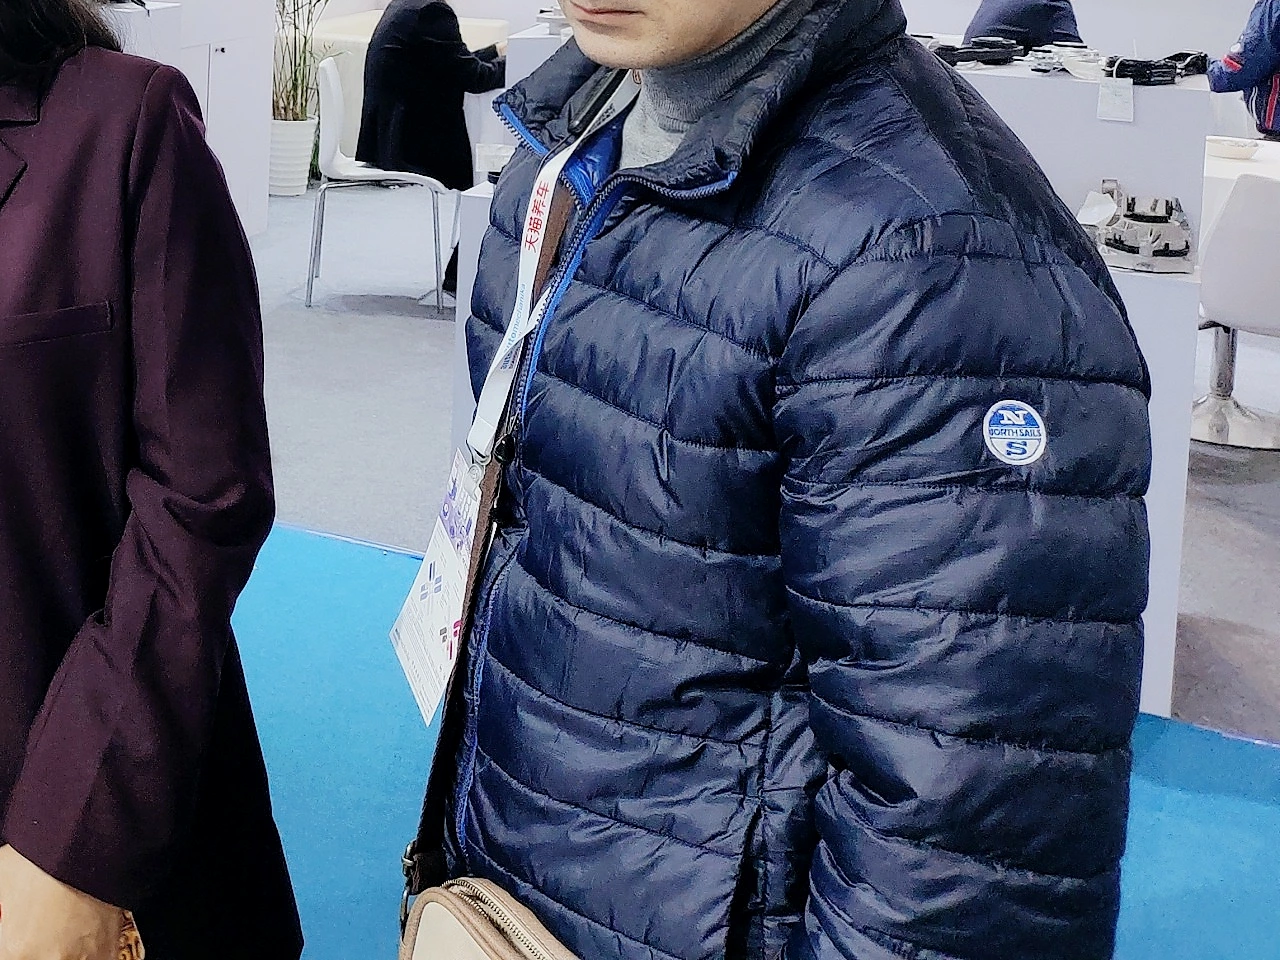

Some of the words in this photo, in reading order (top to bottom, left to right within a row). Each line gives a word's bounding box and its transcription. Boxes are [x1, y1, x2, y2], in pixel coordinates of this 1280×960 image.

[524, 181, 549, 253] 天猫养车
[989, 428, 1018, 436] NORTH
[1020, 429, 1042, 437] SAILS
